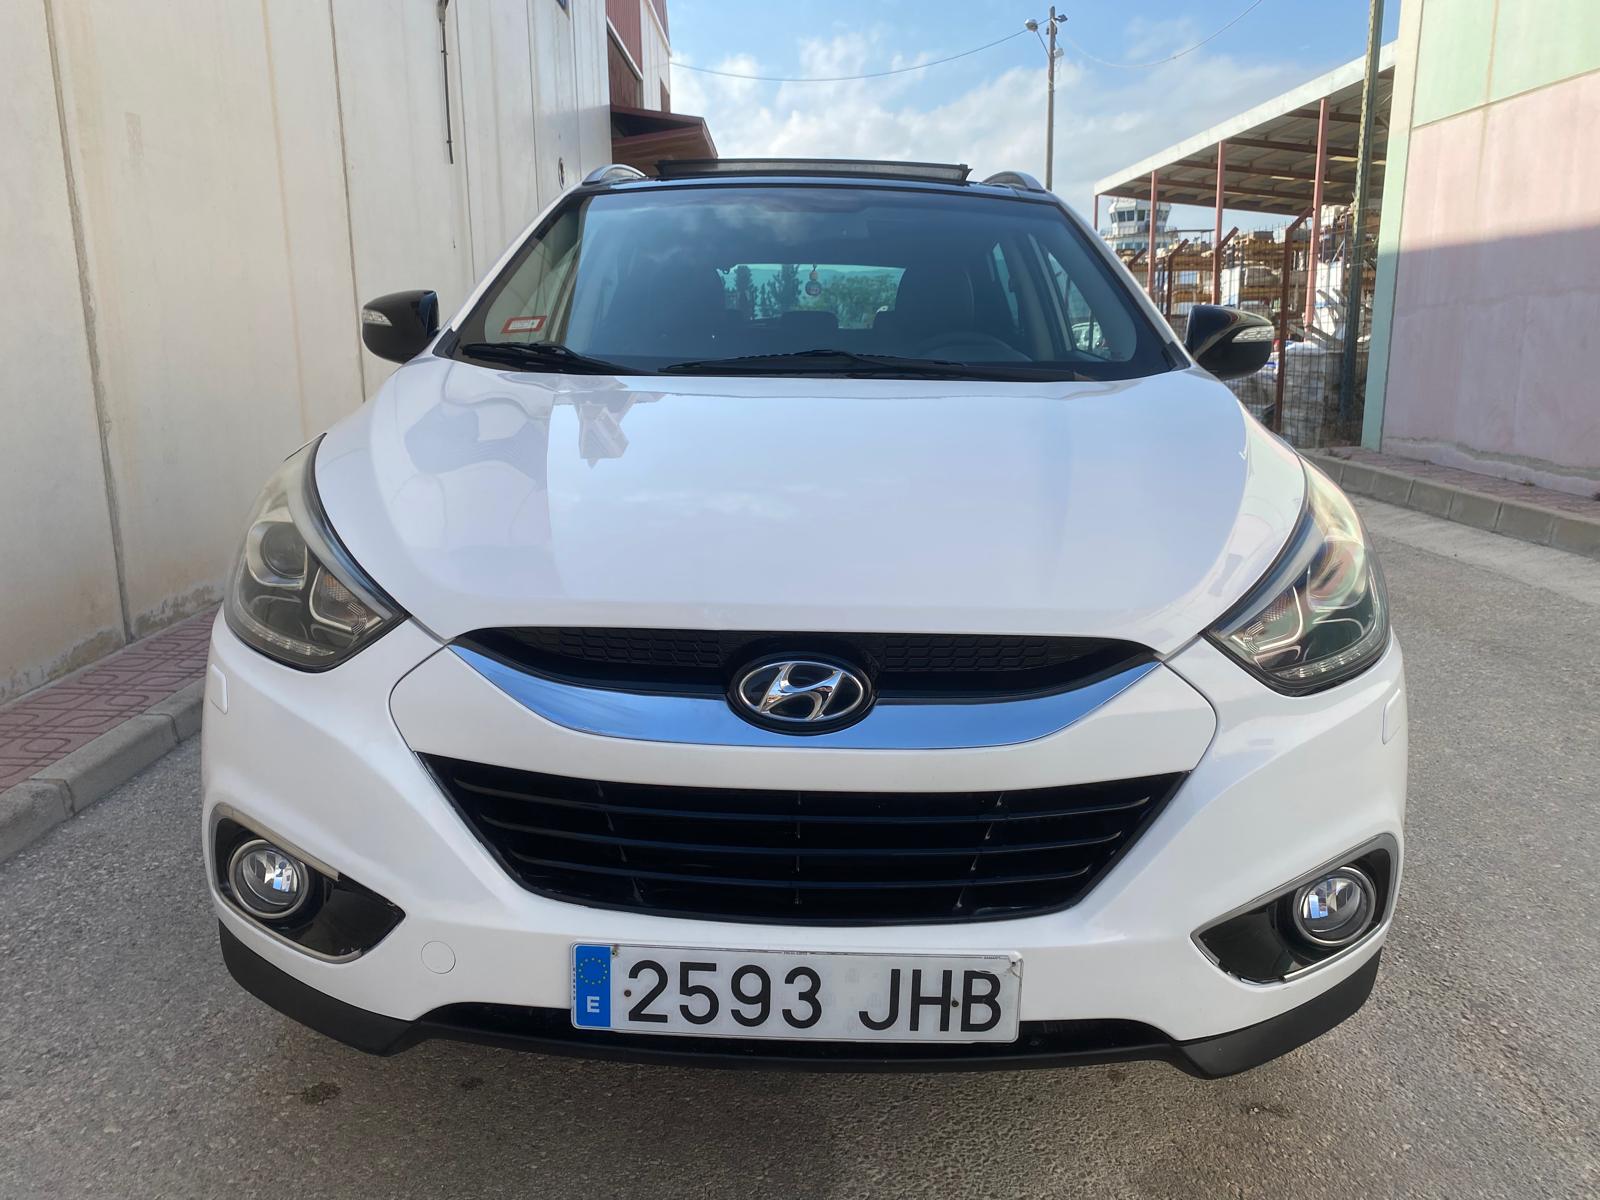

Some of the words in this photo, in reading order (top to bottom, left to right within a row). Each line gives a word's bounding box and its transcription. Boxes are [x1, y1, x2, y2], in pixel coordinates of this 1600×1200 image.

[586, 996, 600, 1014] E
[628, 959, 823, 1030] 2593
[858, 968, 1002, 1033] JHB
